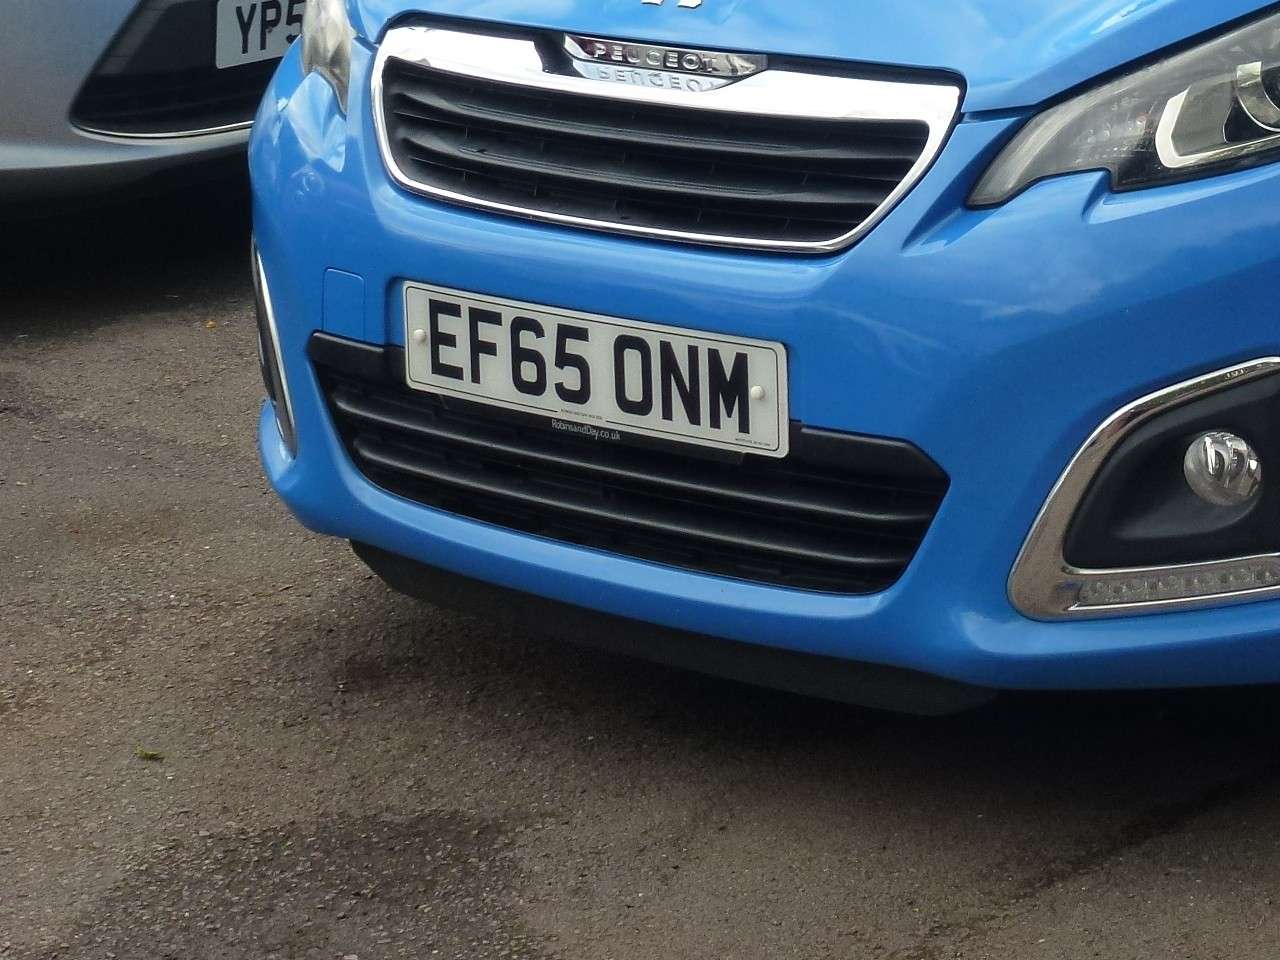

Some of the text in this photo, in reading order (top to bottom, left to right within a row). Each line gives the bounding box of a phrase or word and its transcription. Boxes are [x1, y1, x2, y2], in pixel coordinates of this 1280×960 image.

[592, 42, 721, 72] PEUGEOT
[428, 297, 751, 435] EF65 ONM
